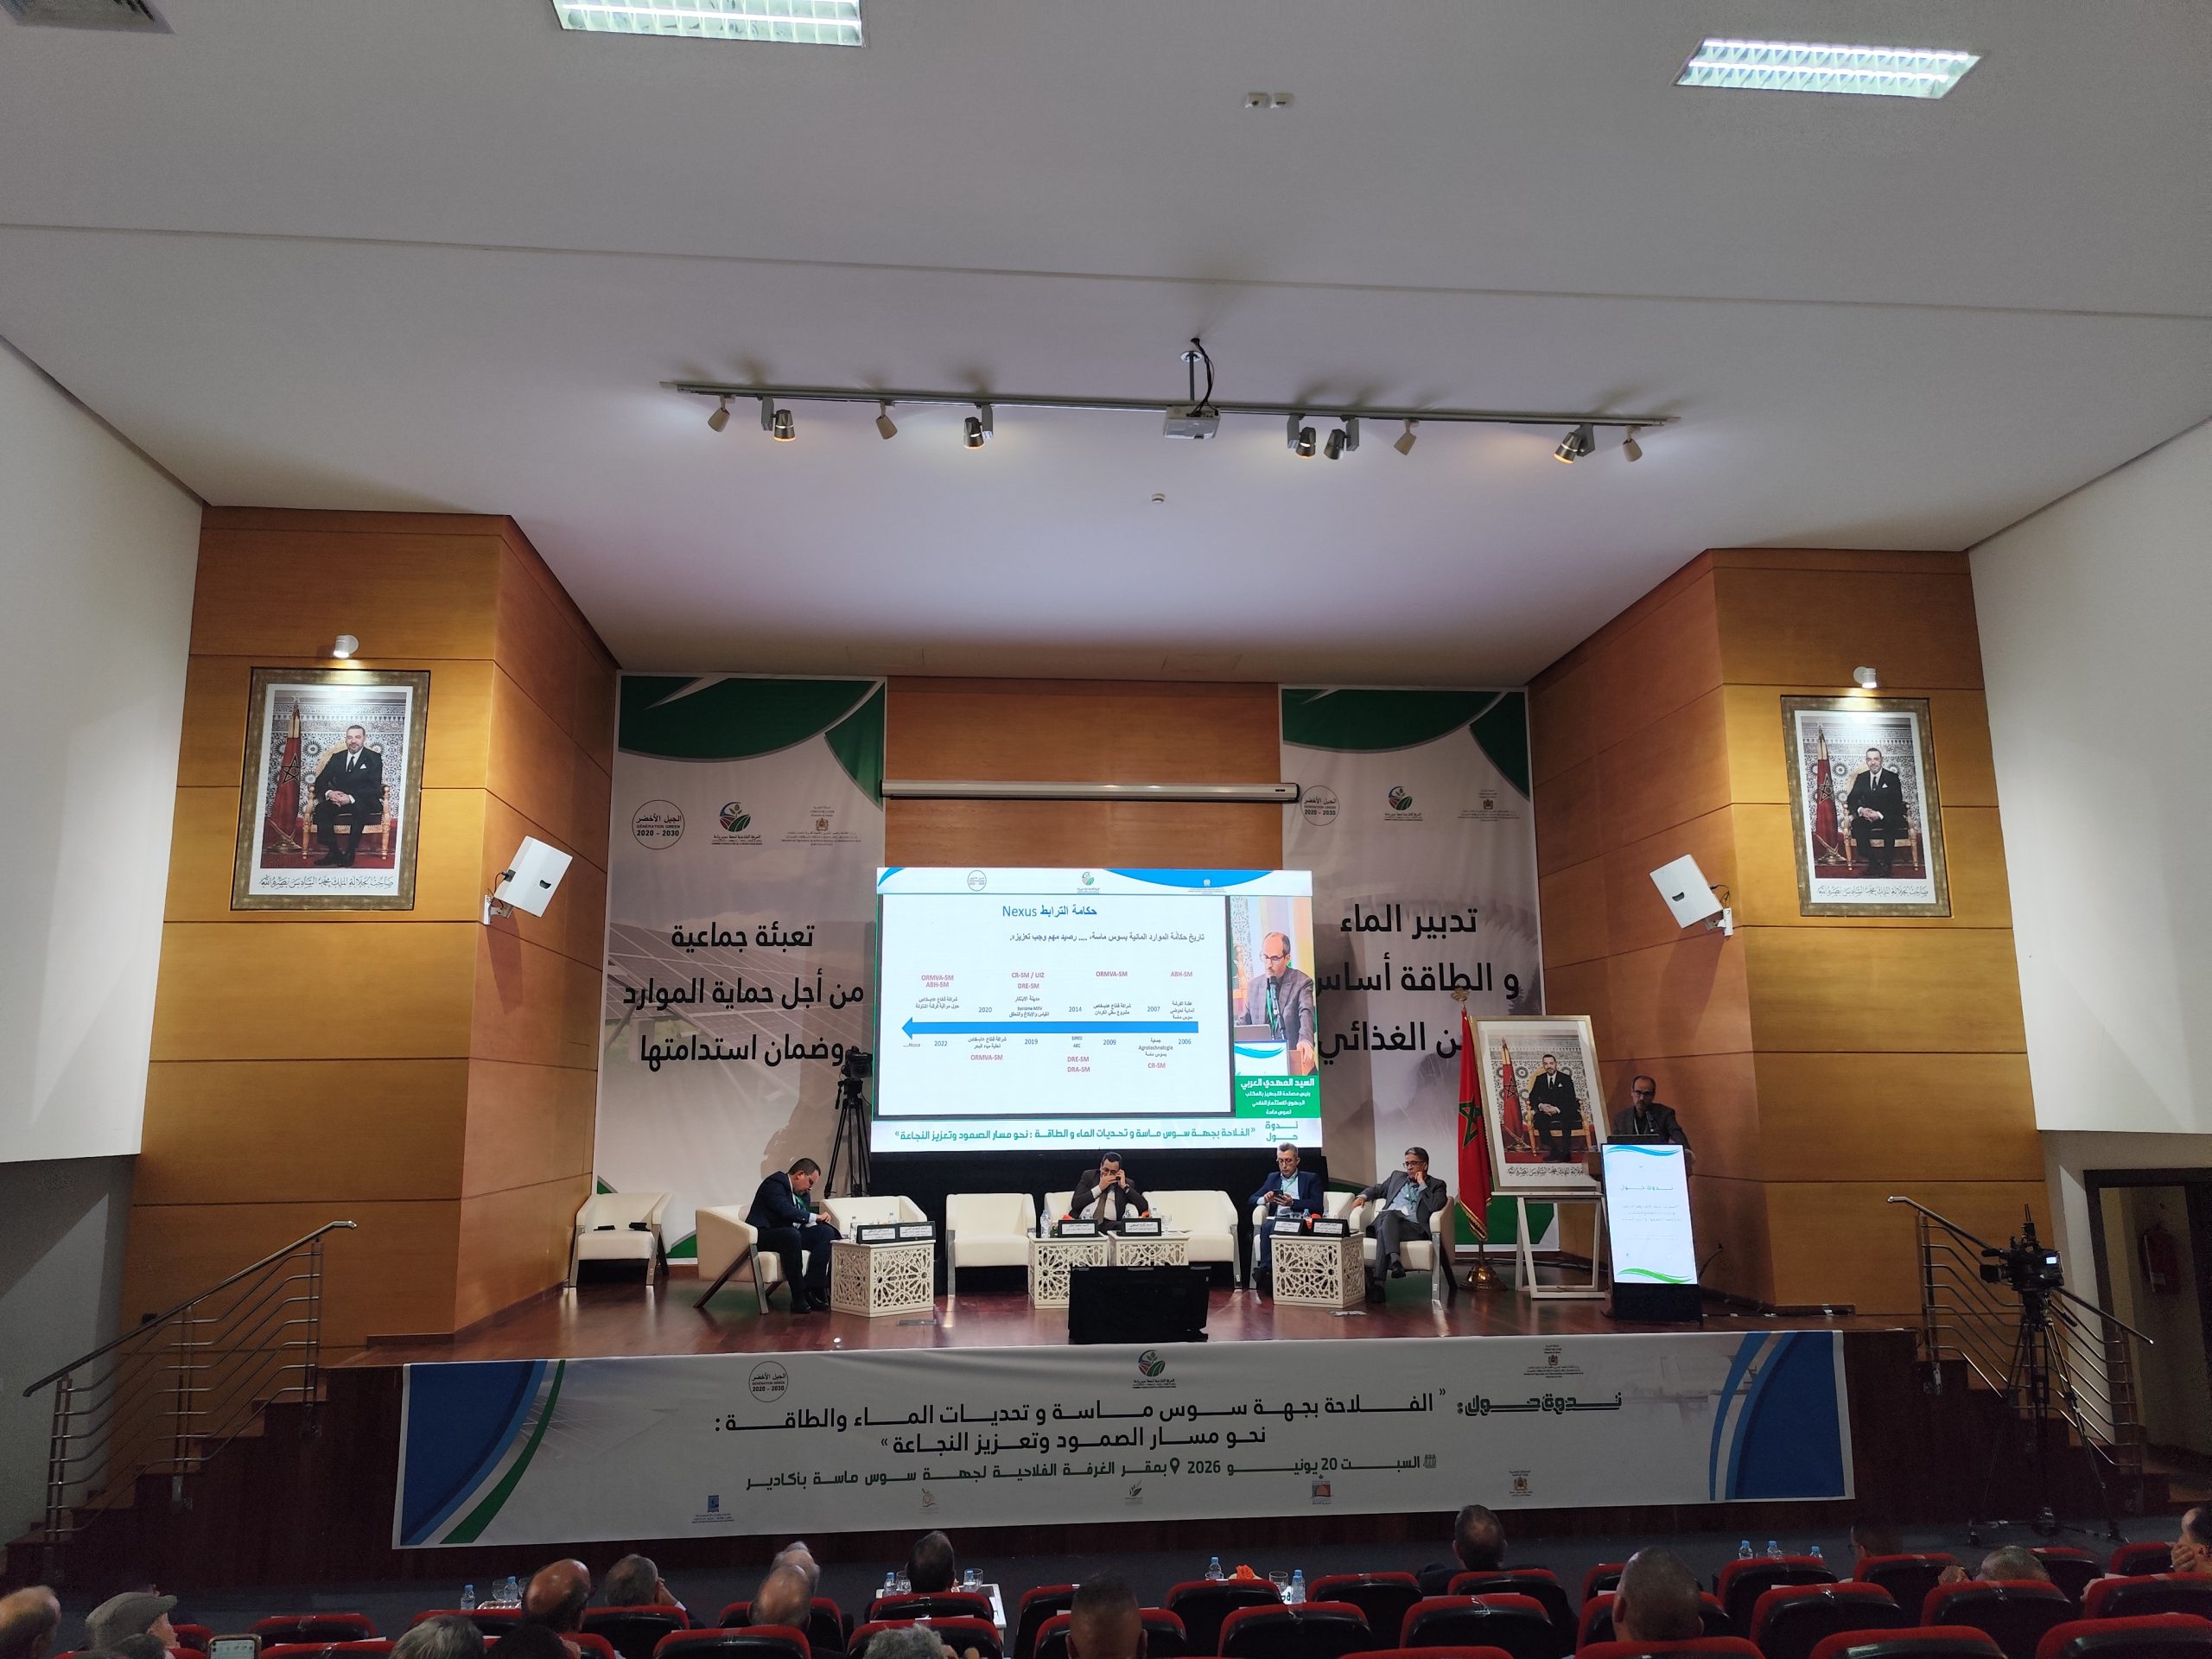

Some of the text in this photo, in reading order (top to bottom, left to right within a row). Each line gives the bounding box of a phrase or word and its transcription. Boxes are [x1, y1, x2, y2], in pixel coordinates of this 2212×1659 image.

[636, 813, 681, 823] الجيل الأخضر
[1002, 904, 1097, 918] حكامة الترابط Nexus
[1341, 904, 1478, 940] تدبير الماء
[671, 920, 816, 953] تعبئة جماعية
[1032, 933, 1047, 942] وجب
[1149, 933, 1168, 942] الموارد
[1188, 933, 1205, 944] تاريخ
[1400, 963, 1492, 992] الطاقة
[623, 968, 864, 1011] من أجل حماية الموارد
[1503, 973, 1519, 1001] و
[1319, 1020, 1426, 1066] الغذائي
[640, 1033, 845, 1072] وضمان استدامتها
[1241, 1078, 1314, 1090] السيد المهدي العربي
[1034, 1128, 1068, 1138] الطاقة
[1077, 1128, 1094, 1137] الماء
[1135, 1128, 1161, 1138] ماسة
[1192, 1128, 1220, 1139] بجهة
[1266, 1122, 1298, 1131] ندوة
[931, 1130, 957, 1141] وتعزيز
[959, 1130, 990, 1141] الصمود
[992, 1129, 1012, 1141] مسار
[1014, 1130, 1029, 1141] نحو
[1096, 1128, 1128, 1140] تحديات
[1166, 1129, 1190, 1140] سوس
[1266, 1132, 1298, 1142] حول
[752, 1372, 771, 1381] الأخضر
[1052, 1400, 1154, 1420] ماسة
[1253, 1398, 1319, 1421] بجهة
[1325, 1393, 1433, 1414] الفلاحة
[1541, 1392, 1622, 1414] ندوة
[854, 1404, 933, 1426] الماء
[940, 1404, 1029, 1426] تحديات
[1036, 1408, 1046, 1426] و
[1160, 1402, 1248, 1421] سوس
[726, 1408, 847, 1433] والطاقة
[893, 1426, 1265, 1457] نحو مسار الصمود وتعزيز النجاعة
[747, 1455, 1420, 1491] السبت 20 يونيو 2026 بمقر الغرفة الفلاحية لجهة سوس ماسة بأكادير
